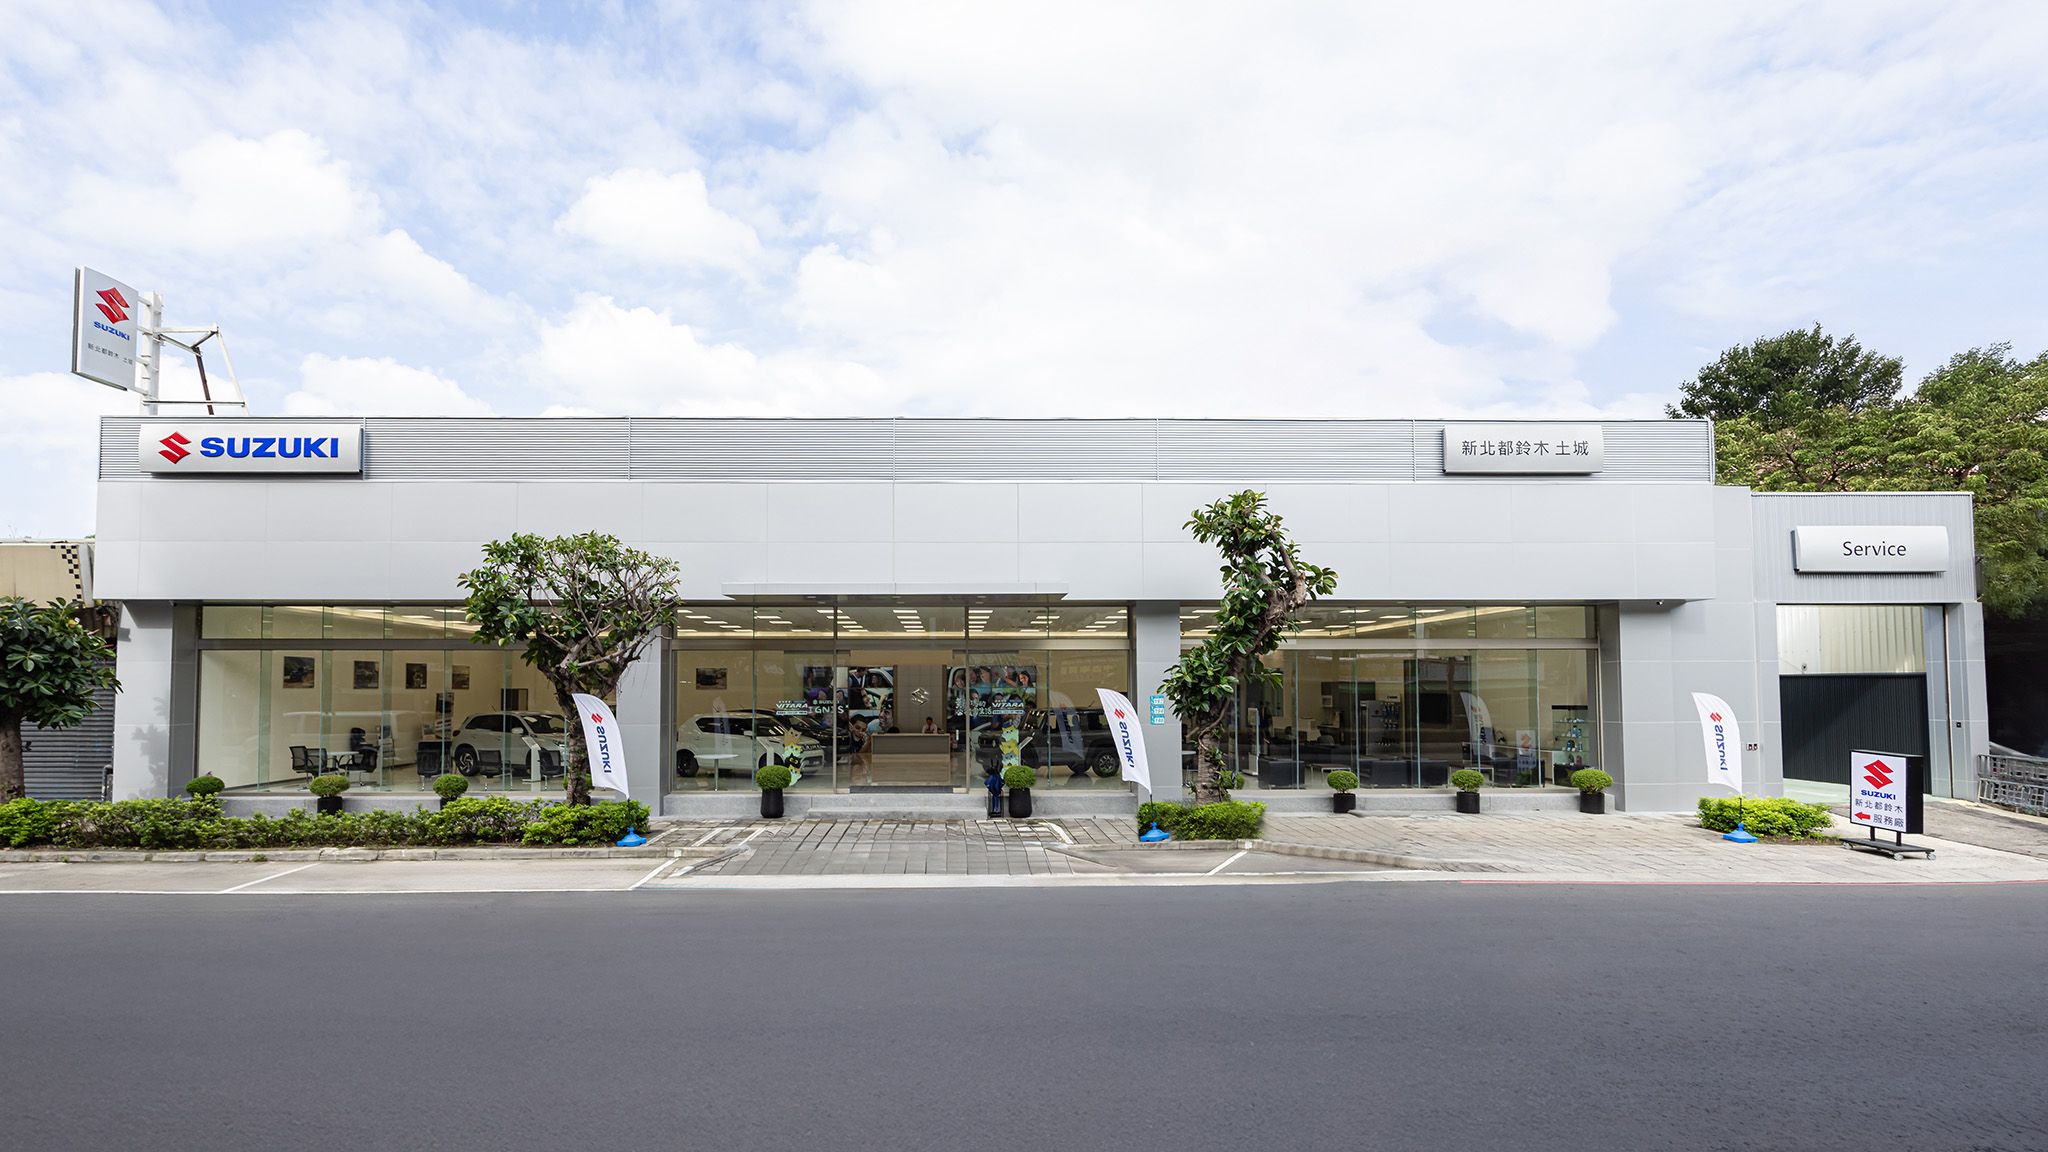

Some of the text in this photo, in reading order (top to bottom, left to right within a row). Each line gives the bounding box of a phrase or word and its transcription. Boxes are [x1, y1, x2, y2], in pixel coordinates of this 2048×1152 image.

[93, 320, 130, 341] SUZUKI
[200, 437, 339, 458] SUZUKI
[1461, 440, 1590, 456] 新北都鈴木 土城
[1842, 540, 1907, 557] Service
[1861, 789, 1896, 800] SUZUKI
[1855, 798, 1904, 814] 新北都鈴木
[1873, 813, 1904, 828] 服務廠
